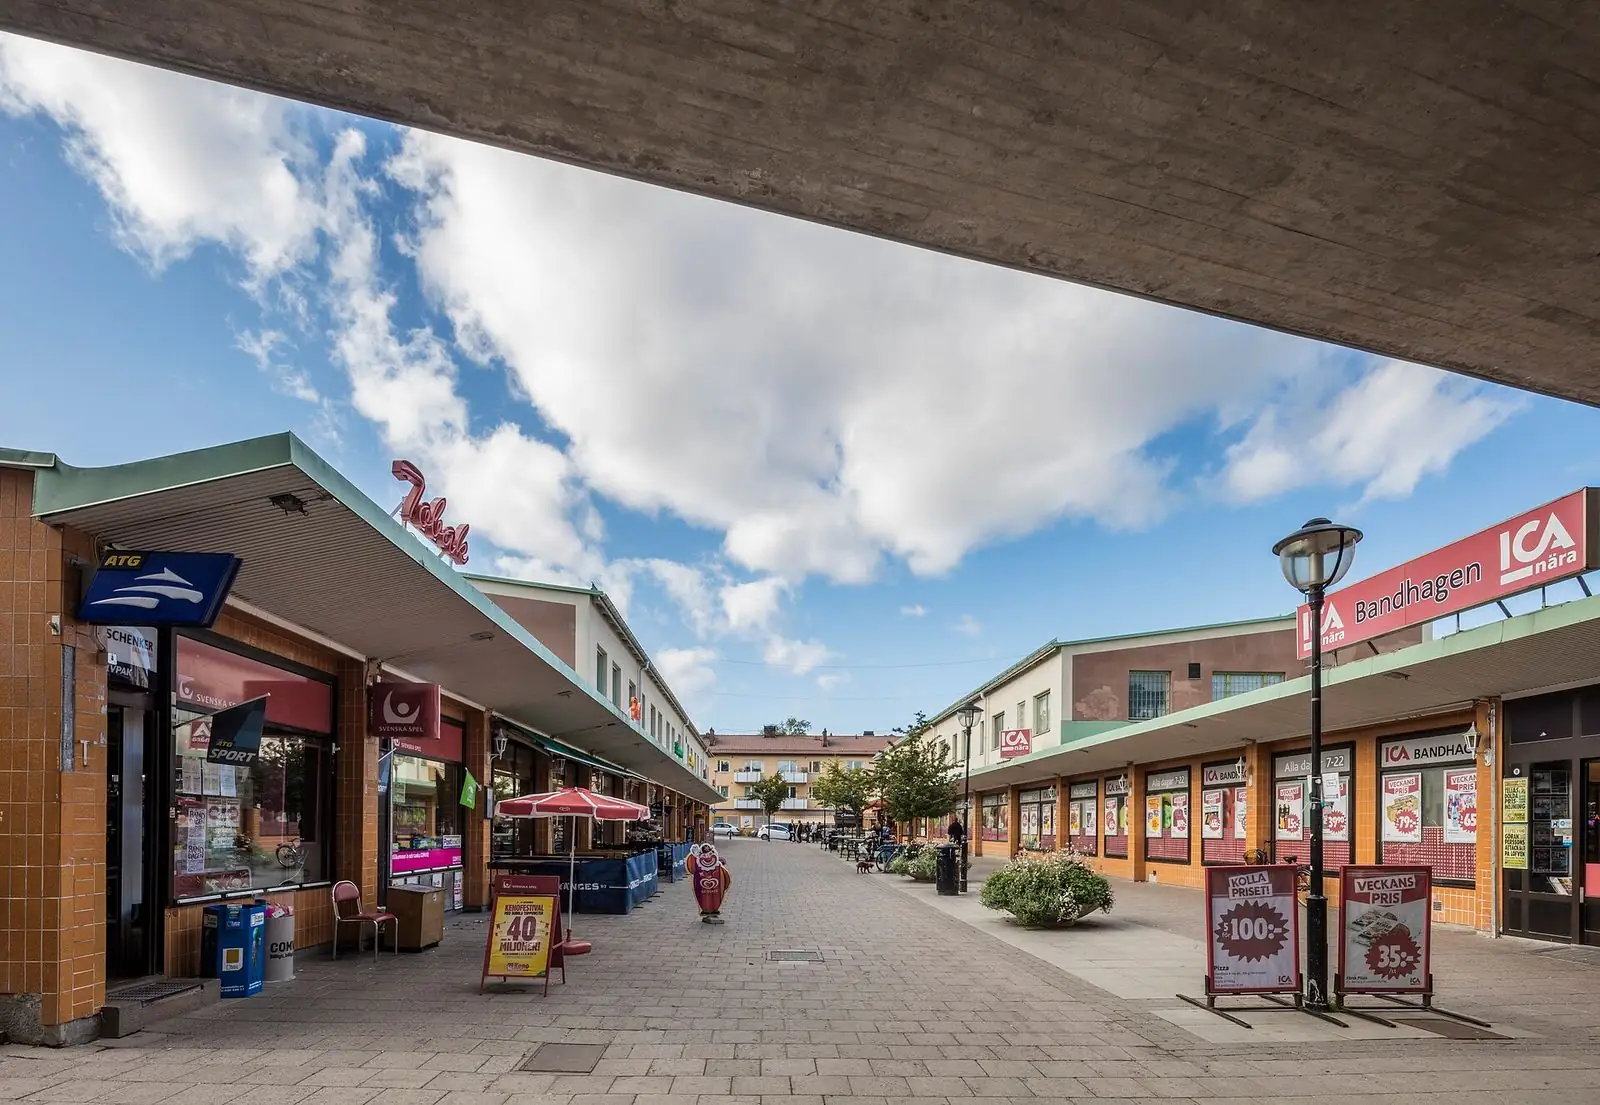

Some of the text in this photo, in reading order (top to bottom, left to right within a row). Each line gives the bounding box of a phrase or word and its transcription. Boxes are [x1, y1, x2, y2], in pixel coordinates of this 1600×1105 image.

[391, 459, 469, 565] Tobak
[1500, 511, 1576, 571] ICA
[104, 555, 141, 566] ATG
[1535, 551, 1577, 574] nära
[1355, 561, 1482, 623] Bandhagen
[106, 628, 154, 652] SCHENKER
[1322, 630, 1345, 645] nära
[196, 693, 227, 708] SVENSKA
[216, 740, 233, 748] ATG
[1002, 731, 1028, 746] ICA
[209, 748, 256, 762] SPORT
[1385, 745, 1410, 763] ICA
[1284, 761, 1299, 773] Alla
[1326, 756, 1344, 768] 7-22
[1205, 769, 1218, 782] ICA
[1389, 778, 1416, 788] VECKANS
[1459, 783, 1474, 791] PRIS
[1231, 873, 1267, 888] KOLLA
[1356, 877, 1414, 892] VECKANS
[1231, 885, 1271, 898] PRISET!
[1371, 892, 1400, 905] PRIS
[504, 904, 544, 912] KENOFESTIVAL
[507, 915, 537, 942] 40
[1223, 917, 1283, 940] 5 100:-
[500, 941, 541, 952] MILJONER!
[1378, 945, 1414, 968] 35:-
[1278, 975, 1292, 983] ICA
